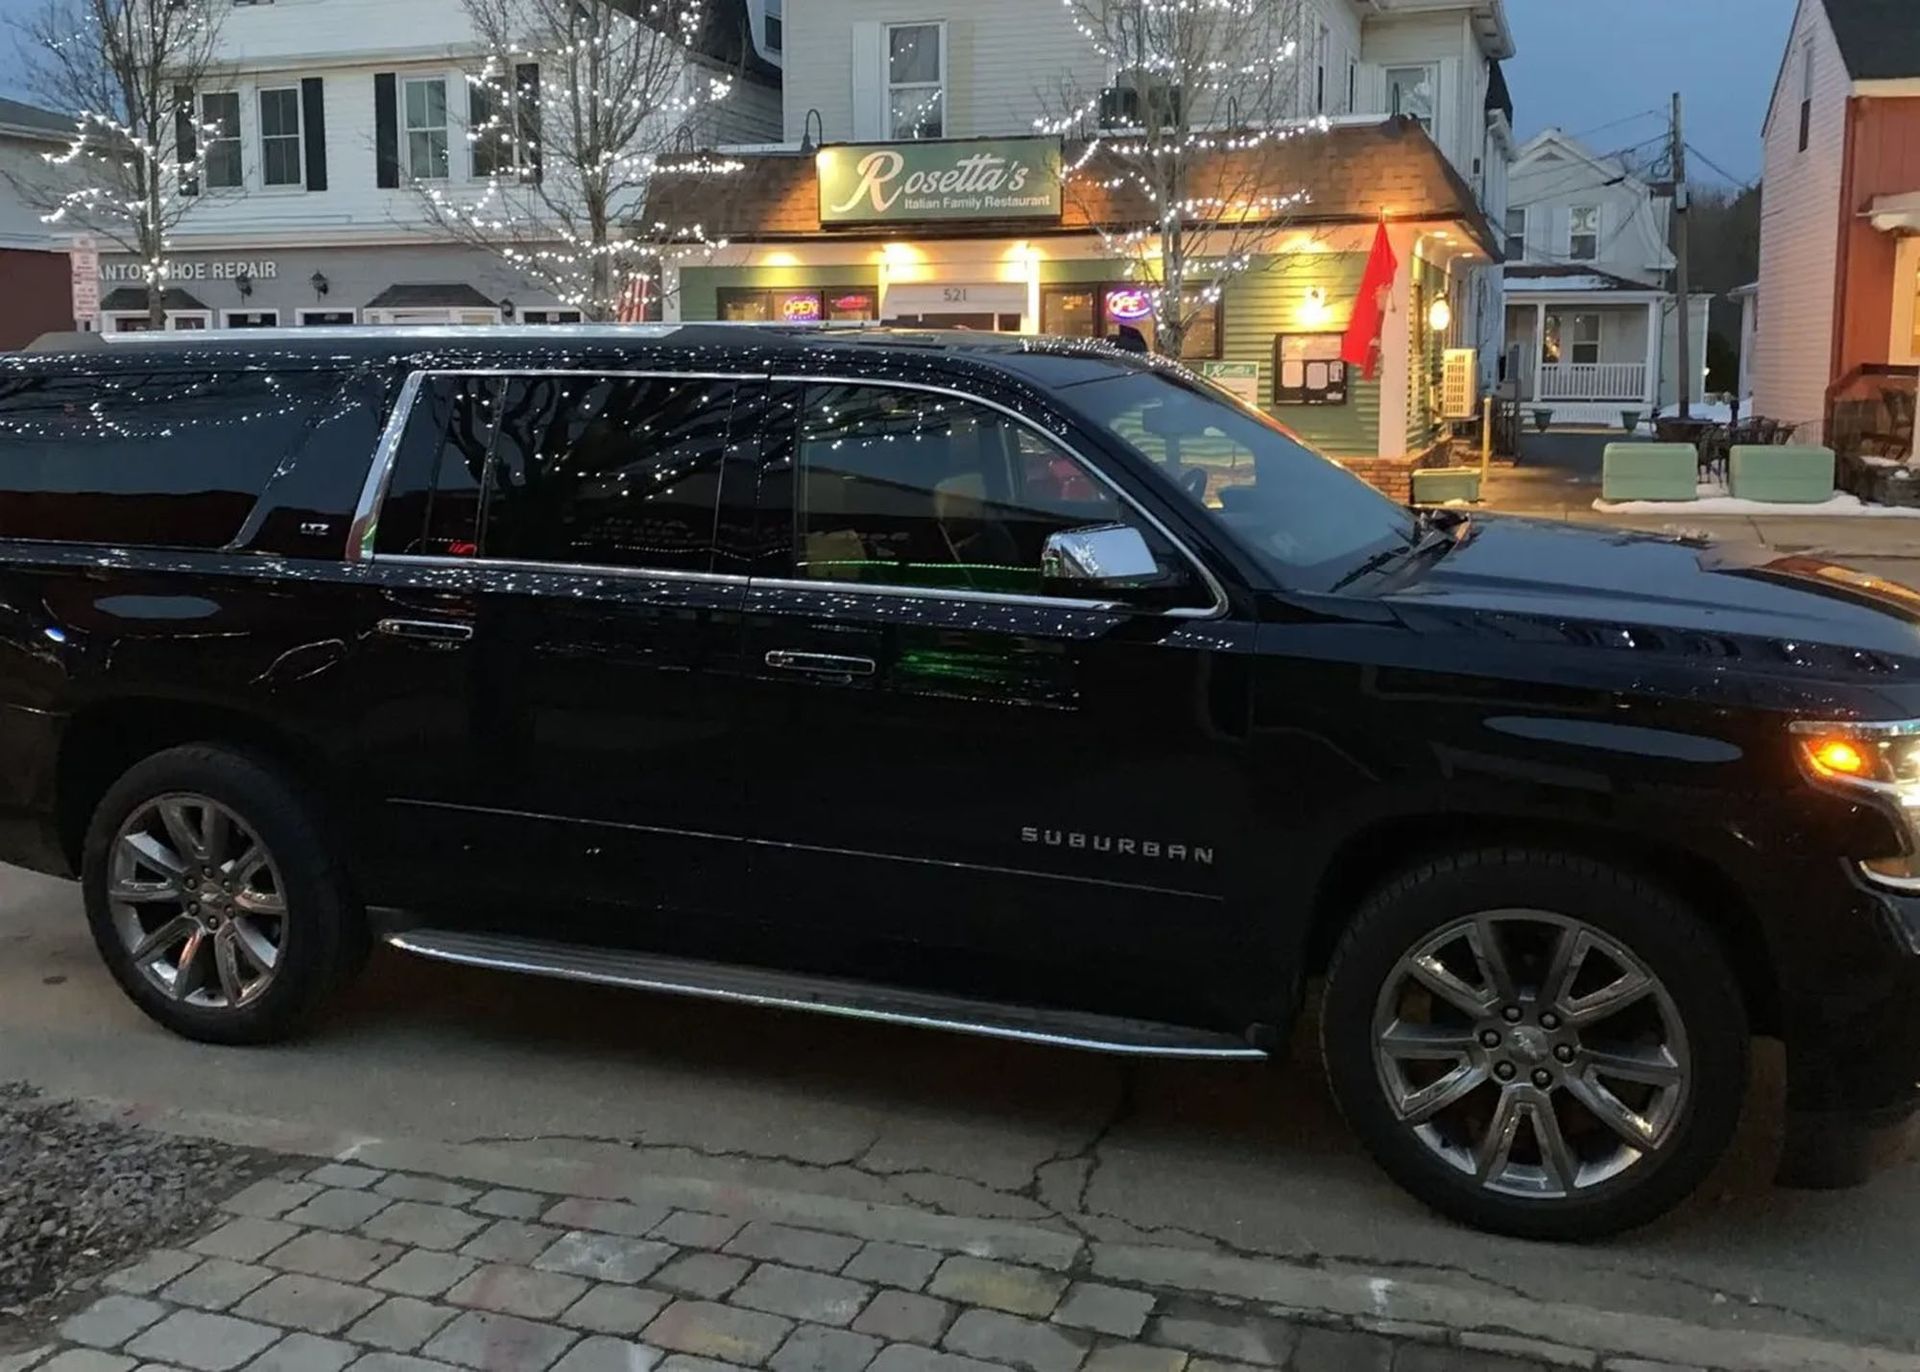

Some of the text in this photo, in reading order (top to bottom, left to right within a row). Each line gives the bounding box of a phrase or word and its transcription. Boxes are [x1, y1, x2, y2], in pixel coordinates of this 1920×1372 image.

[830, 150, 1029, 213] Rosetta's
[905, 194, 1050, 211] Italian Family Restaurant
[212, 261, 277, 279] REPAIR
[943, 287, 967, 302] 521
[783, 299, 819, 317] OPEN
[1021, 826, 1214, 865] SUBURBAN
